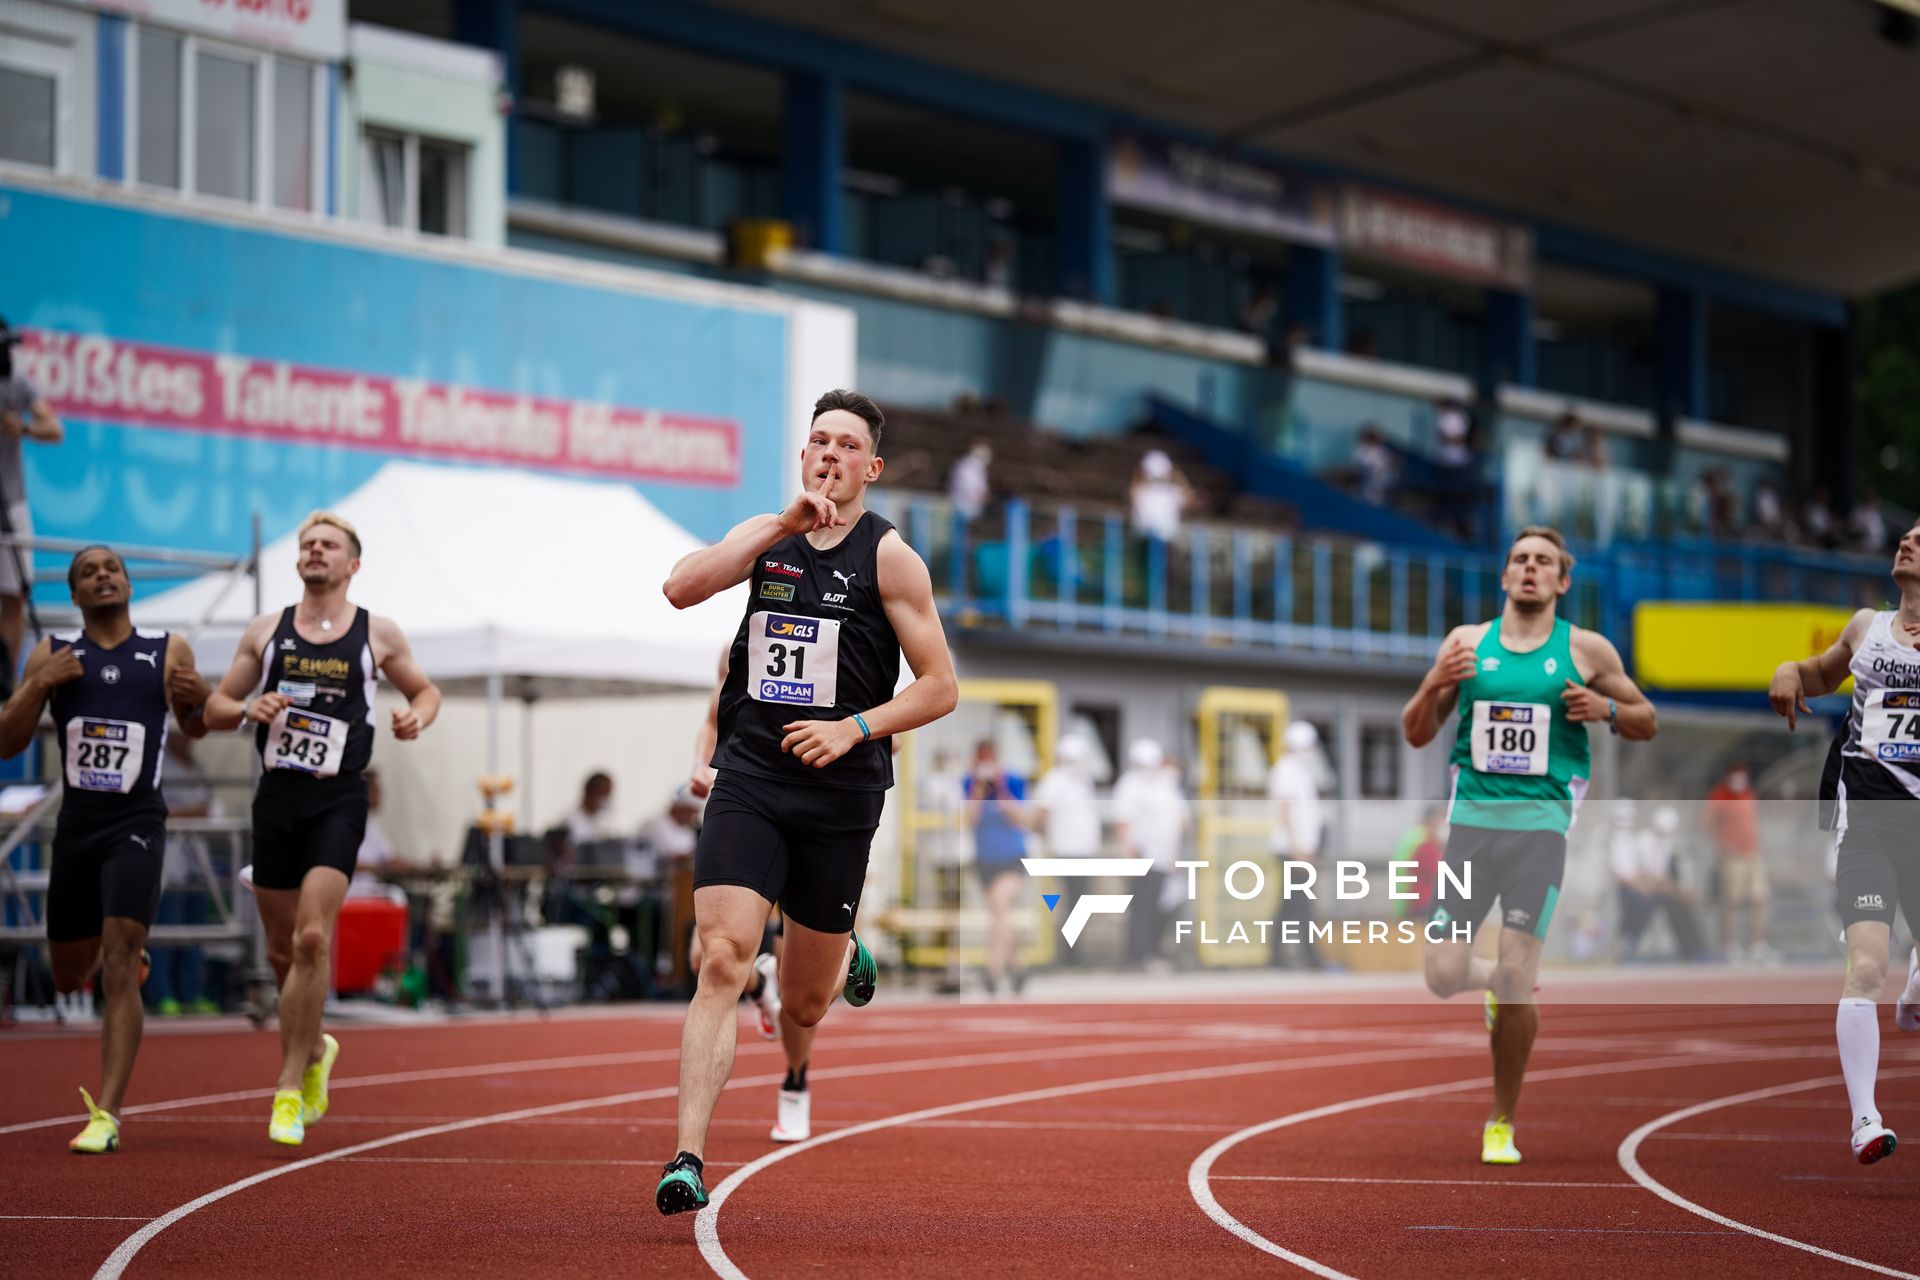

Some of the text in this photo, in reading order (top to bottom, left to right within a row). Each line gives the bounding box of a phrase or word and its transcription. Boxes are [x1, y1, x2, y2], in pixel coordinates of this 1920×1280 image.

[393, 377, 563, 460] Talente
[783, 564, 803, 574] TEAM
[793, 625, 814, 637] GLS
[767, 643, 805, 680] 31
[780, 684, 812, 697] PLAN
[277, 732, 327, 766] 343
[1485, 727, 1536, 752] 180
[78, 742, 129, 770] 287
